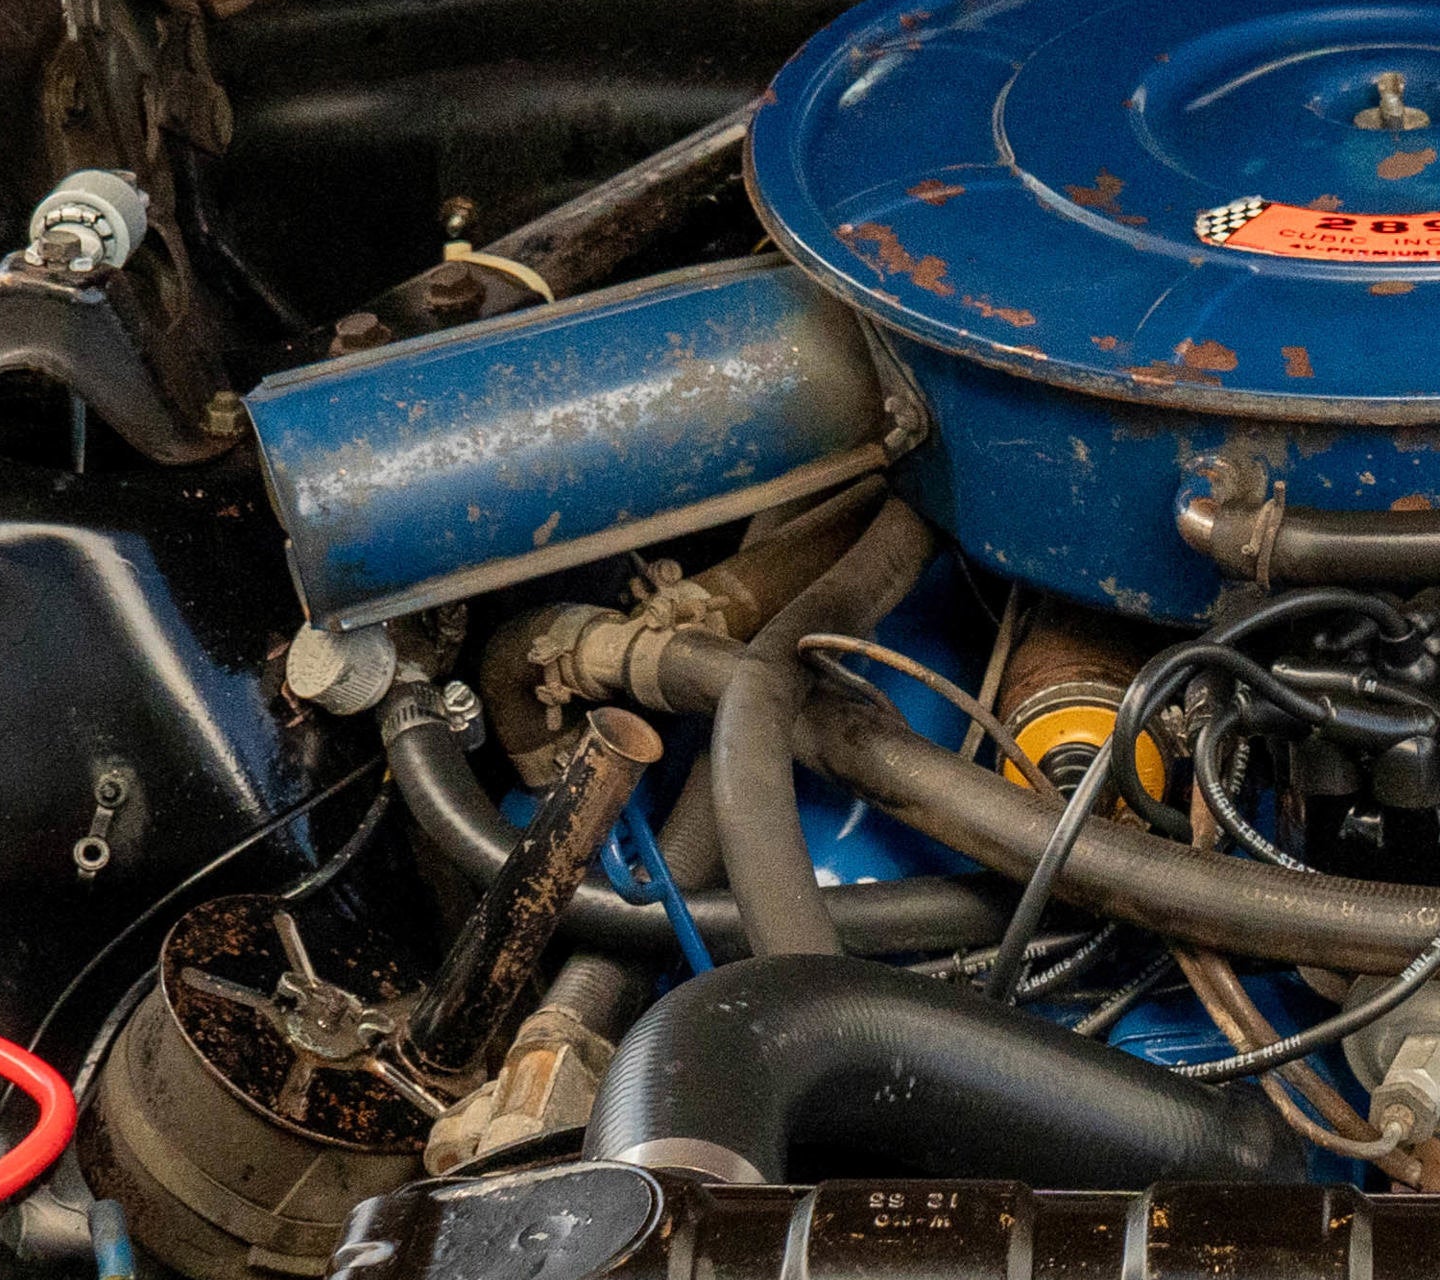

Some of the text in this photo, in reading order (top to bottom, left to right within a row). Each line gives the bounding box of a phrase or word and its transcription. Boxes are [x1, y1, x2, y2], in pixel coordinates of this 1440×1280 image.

[1279, 228, 1367, 245] CUBIC
[1401, 953, 1431, 983] 7MM
[1263, 1034, 1301, 1058] HIGH
[1216, 1052, 1256, 1074] TEMP
